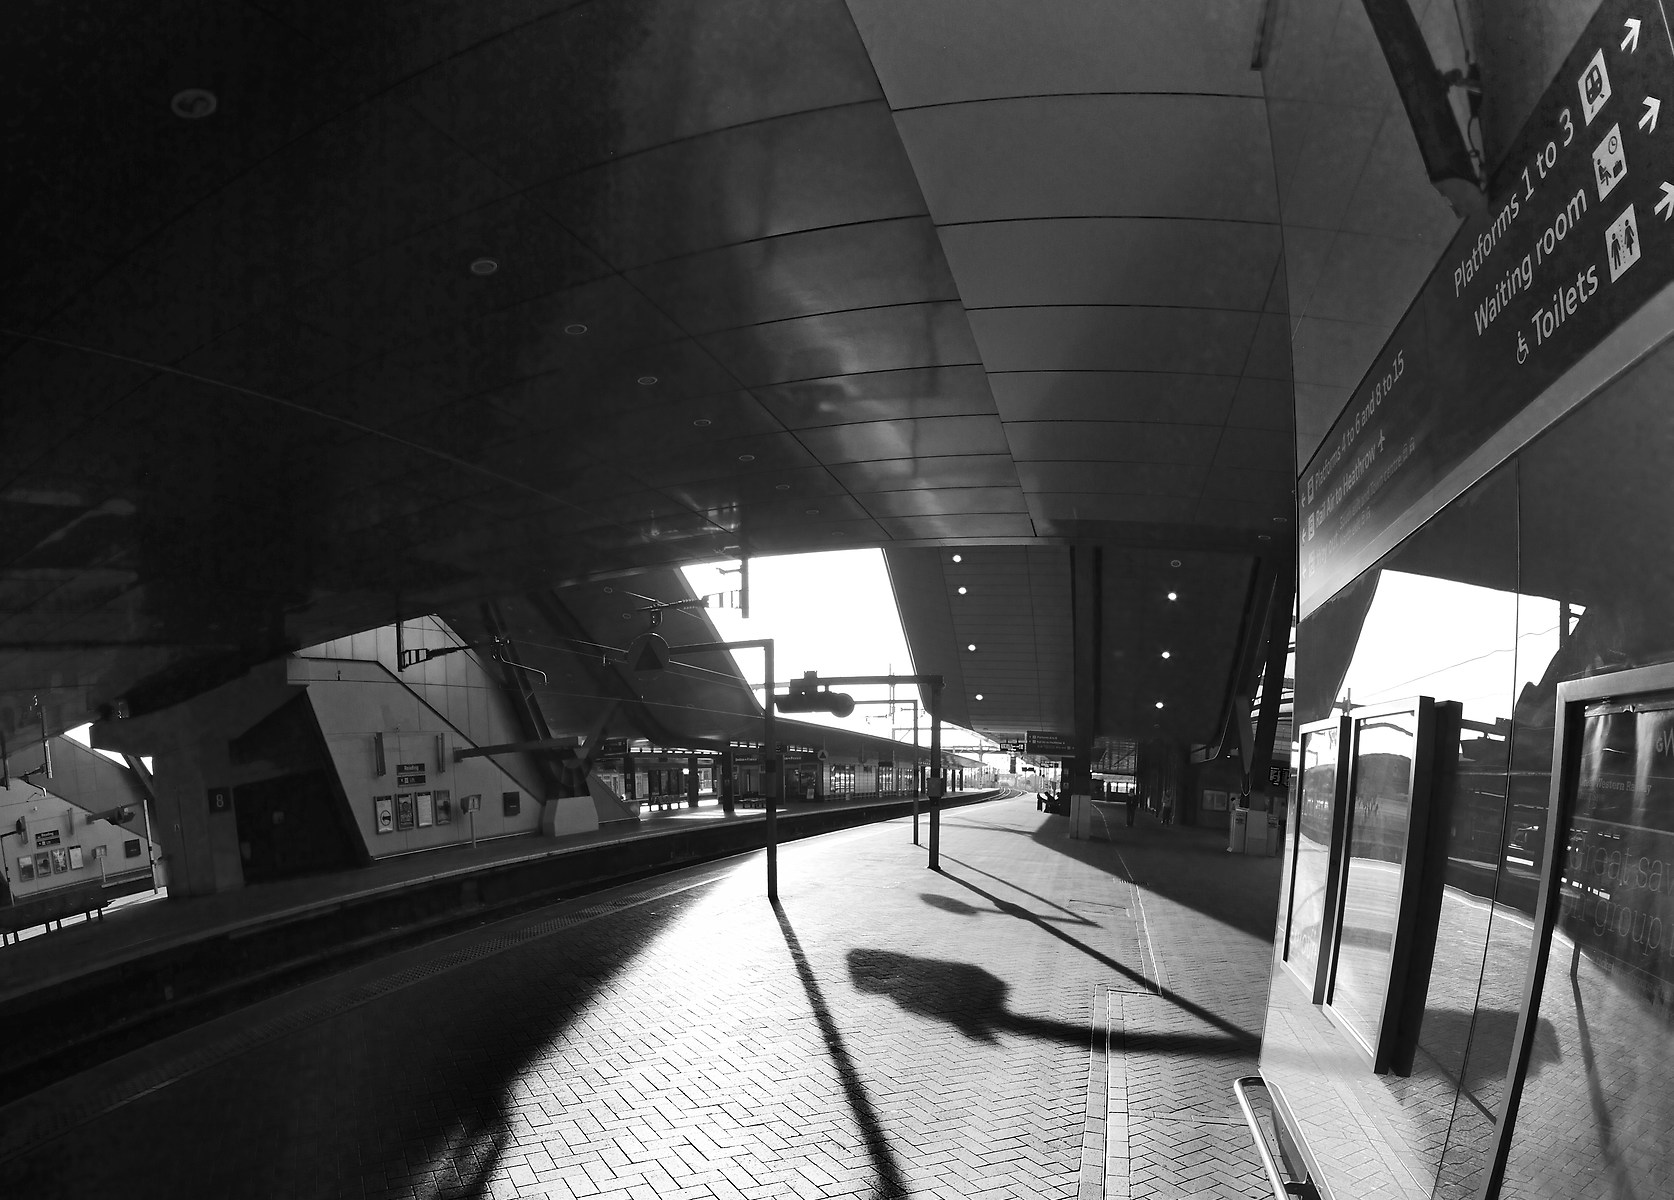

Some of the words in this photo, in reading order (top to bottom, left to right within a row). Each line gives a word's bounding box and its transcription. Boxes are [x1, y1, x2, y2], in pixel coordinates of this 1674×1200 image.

[1454, 193, 1519, 297] Platforms
[1521, 166, 1535, 201] 1
[1537, 141, 1557, 179] to
[1559, 108, 1574, 147] 3
[1474, 254, 1533, 336] Waiting
[1536, 188, 1588, 265] room
[1532, 264, 1599, 345] Toilets
[1355, 412, 1361, 434] 6
[1361, 391, 1375, 426] and
[1375, 383, 1382, 406] 8
[1383, 373, 1392, 396] to
[1392, 350, 1404, 383] 15
[1343, 443, 1376, 496] Heathrow
[216, 793, 224, 808] 8
[1596, 777, 1625, 792] Western
[1593, 899, 1663, 957] group
